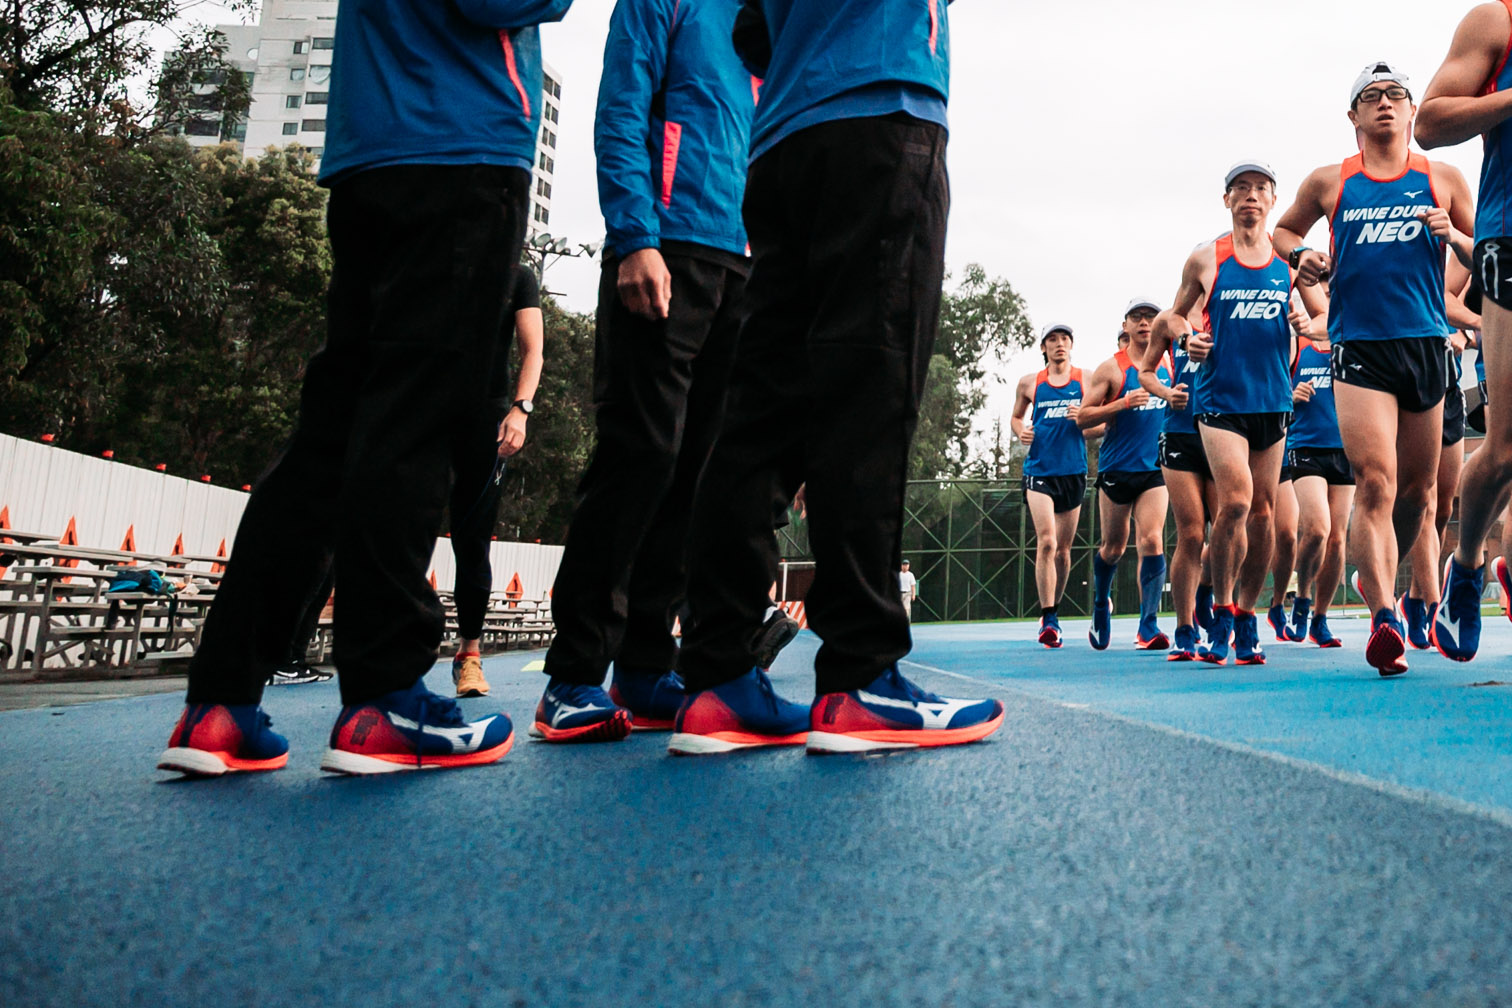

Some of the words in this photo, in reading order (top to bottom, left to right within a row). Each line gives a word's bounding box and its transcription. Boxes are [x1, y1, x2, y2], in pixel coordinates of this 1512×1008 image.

[1342, 206, 1391, 223] WAVE
[1388, 204, 1435, 219] DUE
[1355, 220, 1423, 245] NEO
[1220, 289, 1261, 301] WAVE
[1229, 301, 1282, 320] NEO
[1300, 366, 1328, 376] WAVE
[1310, 375, 1332, 389] NE
[1038, 399, 1060, 408] WAVE
[1133, 396, 1167, 411] EO
